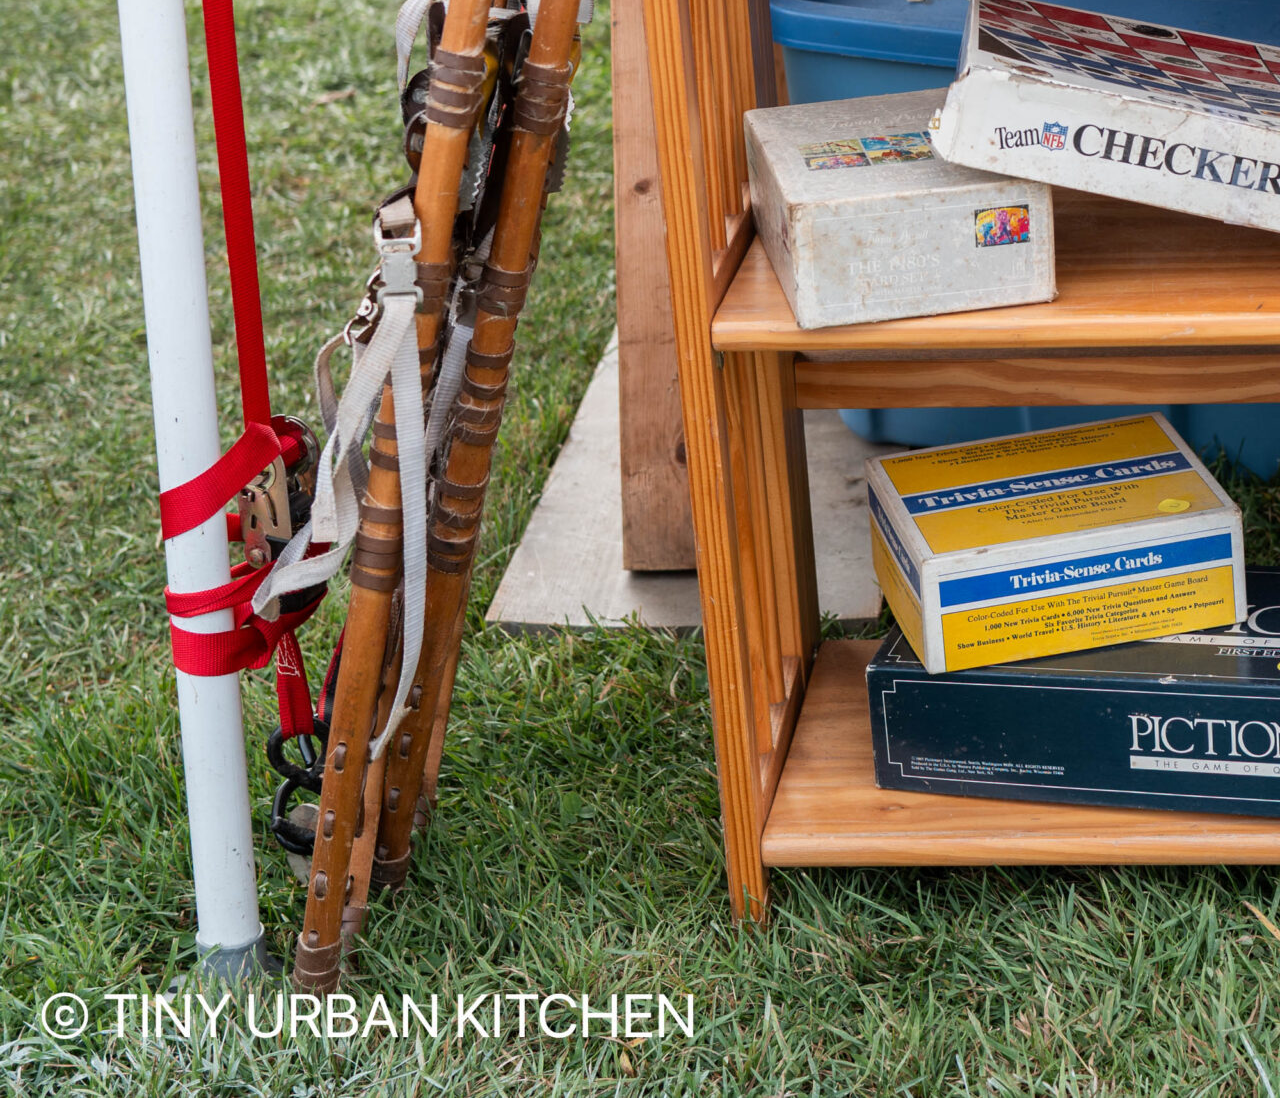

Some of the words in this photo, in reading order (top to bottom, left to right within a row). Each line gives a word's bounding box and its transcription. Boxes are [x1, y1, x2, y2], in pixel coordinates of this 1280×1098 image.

[994, 125, 1042, 151] Team
[848, 259, 882, 276] THE
[918, 470, 1090, 509] Trivia-Sense
[1097, 457, 1178, 480] Cards
[1057, 492, 1078, 500] For
[1083, 488, 1106, 496] Use
[1110, 483, 1140, 492] With
[1004, 507, 1026, 515] The
[1030, 501, 1071, 511] Trivial
[1006, 510, 1047, 521] Master
[1050, 504, 1088, 514] Game
[1091, 497, 1127, 507] Board
[1010, 560, 1111, 590] Trivia-Sense
[1115, 552, 1163, 572] Cards
[967, 607, 1014, 622] Color-Coded
[1016, 606, 1029, 615] For
[1031, 604, 1045, 612] Use
[1047, 600, 1065, 609] With
[1067, 597, 1080, 605] The
[1082, 593, 1106, 603] Trivial
[1137, 584, 1162, 594] Master
[1164, 580, 1185, 589] Game
[1187, 575, 1209, 585] Board
[984, 623, 1002, 632] 1,000
[1004, 620, 1018, 628] New
[1020, 617, 1039, 625] Trivia
[1041, 613, 1060, 622] Cards
[1066, 608, 1085, 618] 6,000
[1086, 606, 1101, 614] New
[1103, 603, 1122, 611] Trivia
[1123, 597, 1155, 608] Questions
[1156, 594, 1168, 602] and
[1169, 590, 1197, 600] Answers
[1044, 621, 1055, 629] Six
[1057, 615, 1083, 626] Favorite
[1085, 613, 1104, 622] Trivia
[1105, 608, 1138, 619] Categories
[957, 641, 975, 650] Show
[977, 637, 1005, 647] Business
[1011, 632, 1033, 641] World
[1034, 628, 1055, 637] Travel
[1061, 623, 1076, 632] U.S.
[1077, 619, 1101, 629] History
[1108, 613, 1141, 624] Literature
[1149, 608, 1160, 618] Art
[1166, 605, 1188, 615] Sports
[1193, 597, 1225, 609] Potpourri
[1217, 646, 1258, 658] FIRST
[1243, 638, 1271, 646] OF
[1155, 759, 1179, 770] THE
[1192, 762, 1230, 772] GAME
[1243, 764, 1269, 774] OF
